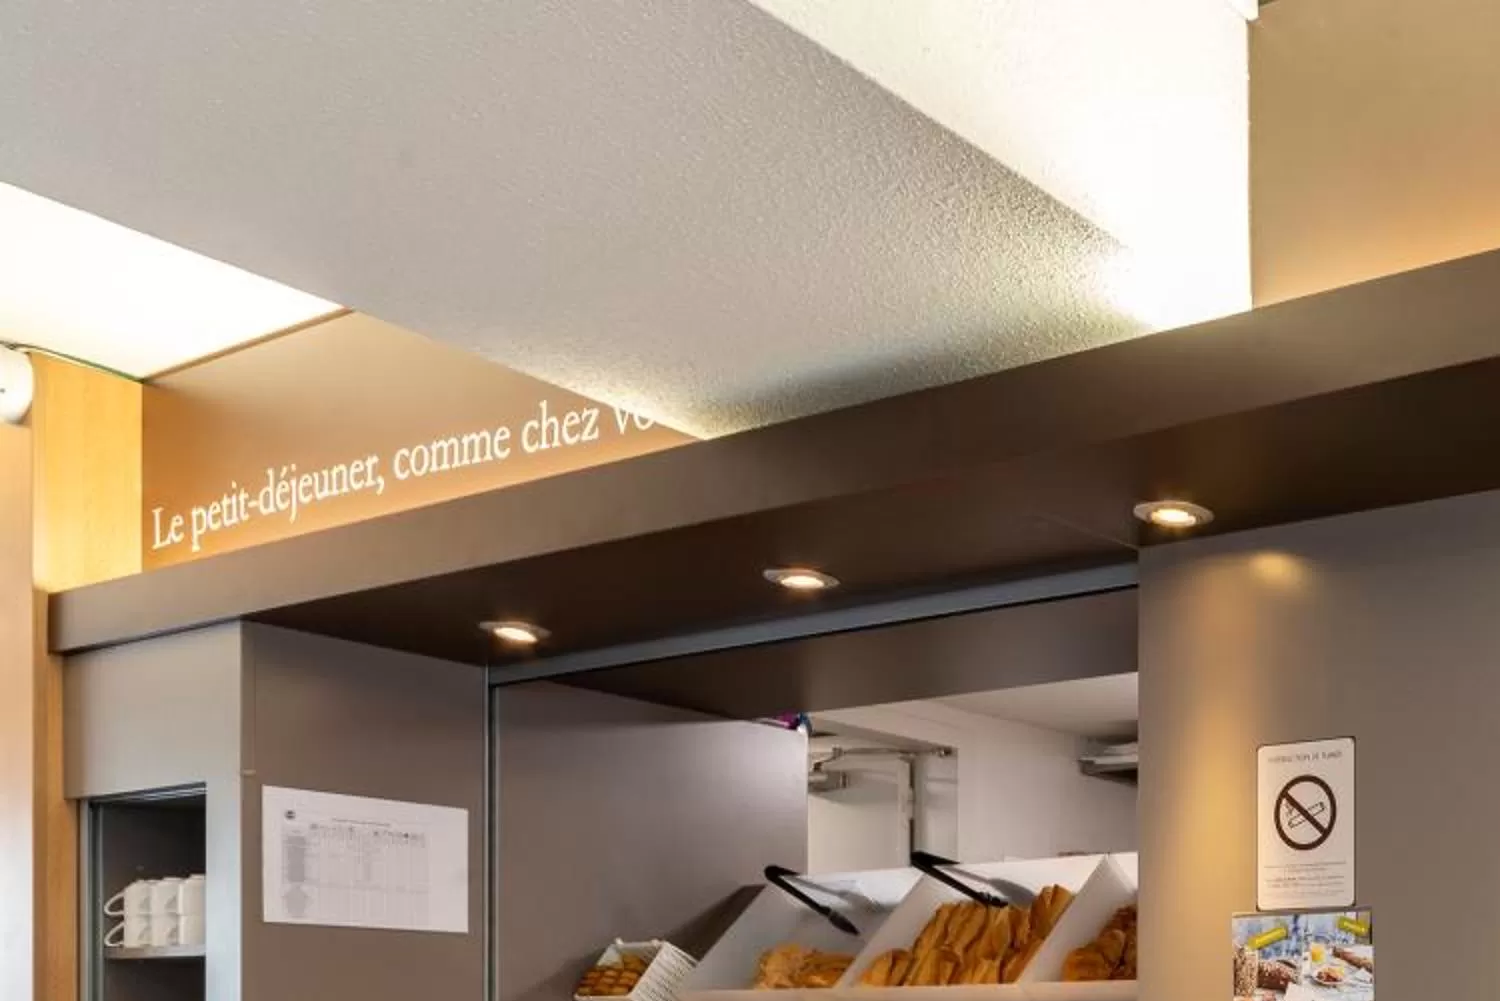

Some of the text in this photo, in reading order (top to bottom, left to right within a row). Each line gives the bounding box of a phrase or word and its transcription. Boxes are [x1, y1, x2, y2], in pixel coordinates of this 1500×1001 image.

[152, 507, 184, 550] Le
[190, 455, 386, 552] petit-déjeuner,
[392, 427, 512, 481] comme
[520, 400, 600, 454] chez
